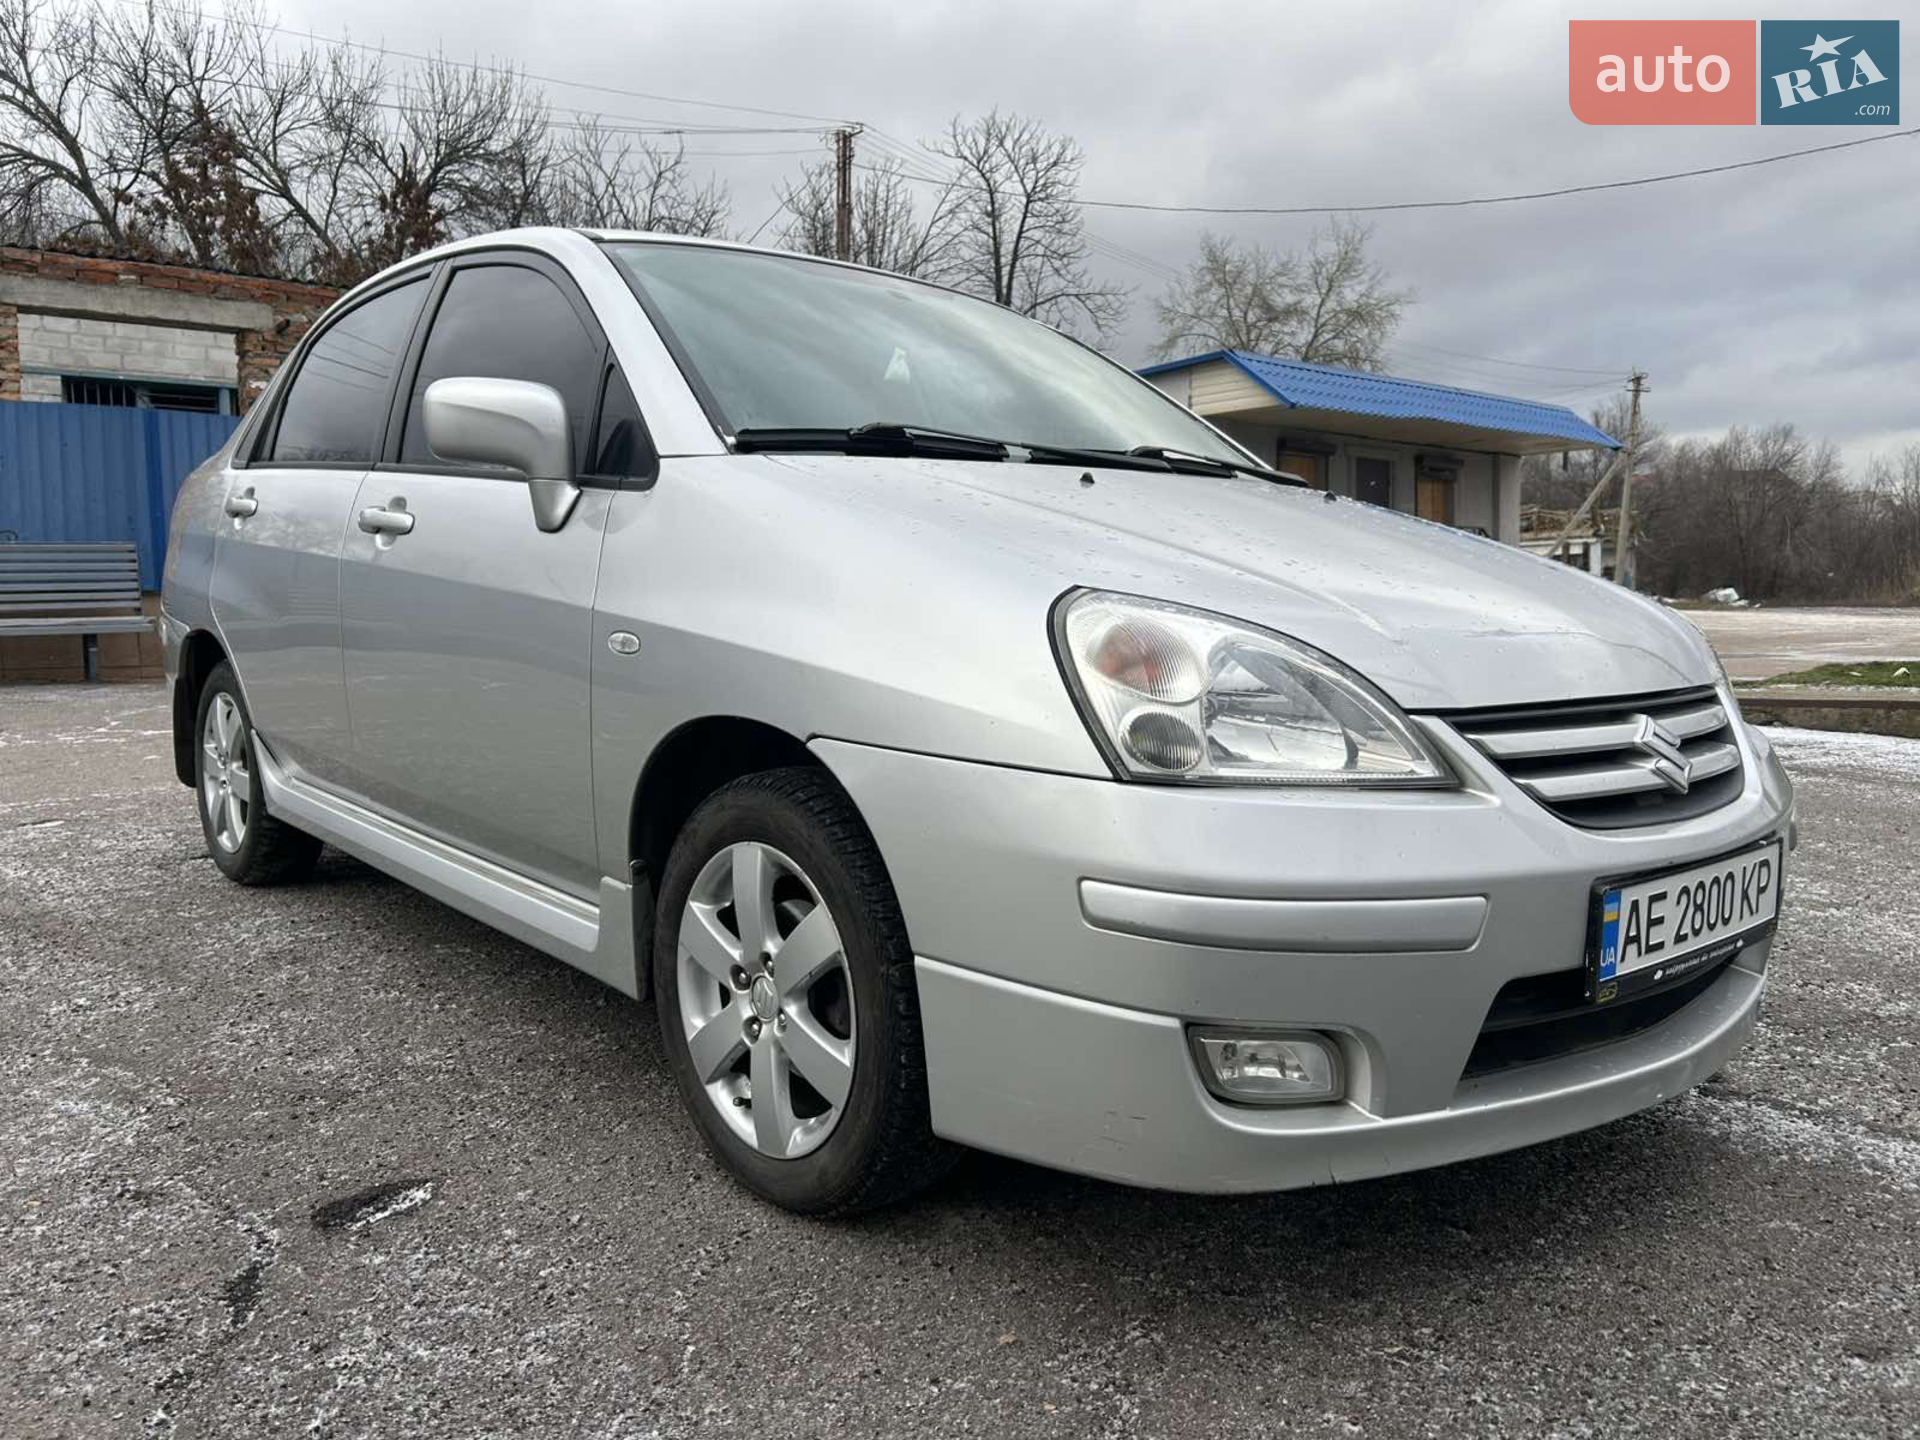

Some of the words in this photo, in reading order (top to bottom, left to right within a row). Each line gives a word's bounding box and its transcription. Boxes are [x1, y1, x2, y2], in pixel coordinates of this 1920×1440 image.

[1620, 890, 1668, 964] AE
[1673, 871, 1735, 945] 2800
[1739, 858, 1771, 921] KP
[1600, 947, 1615, 967] UA
